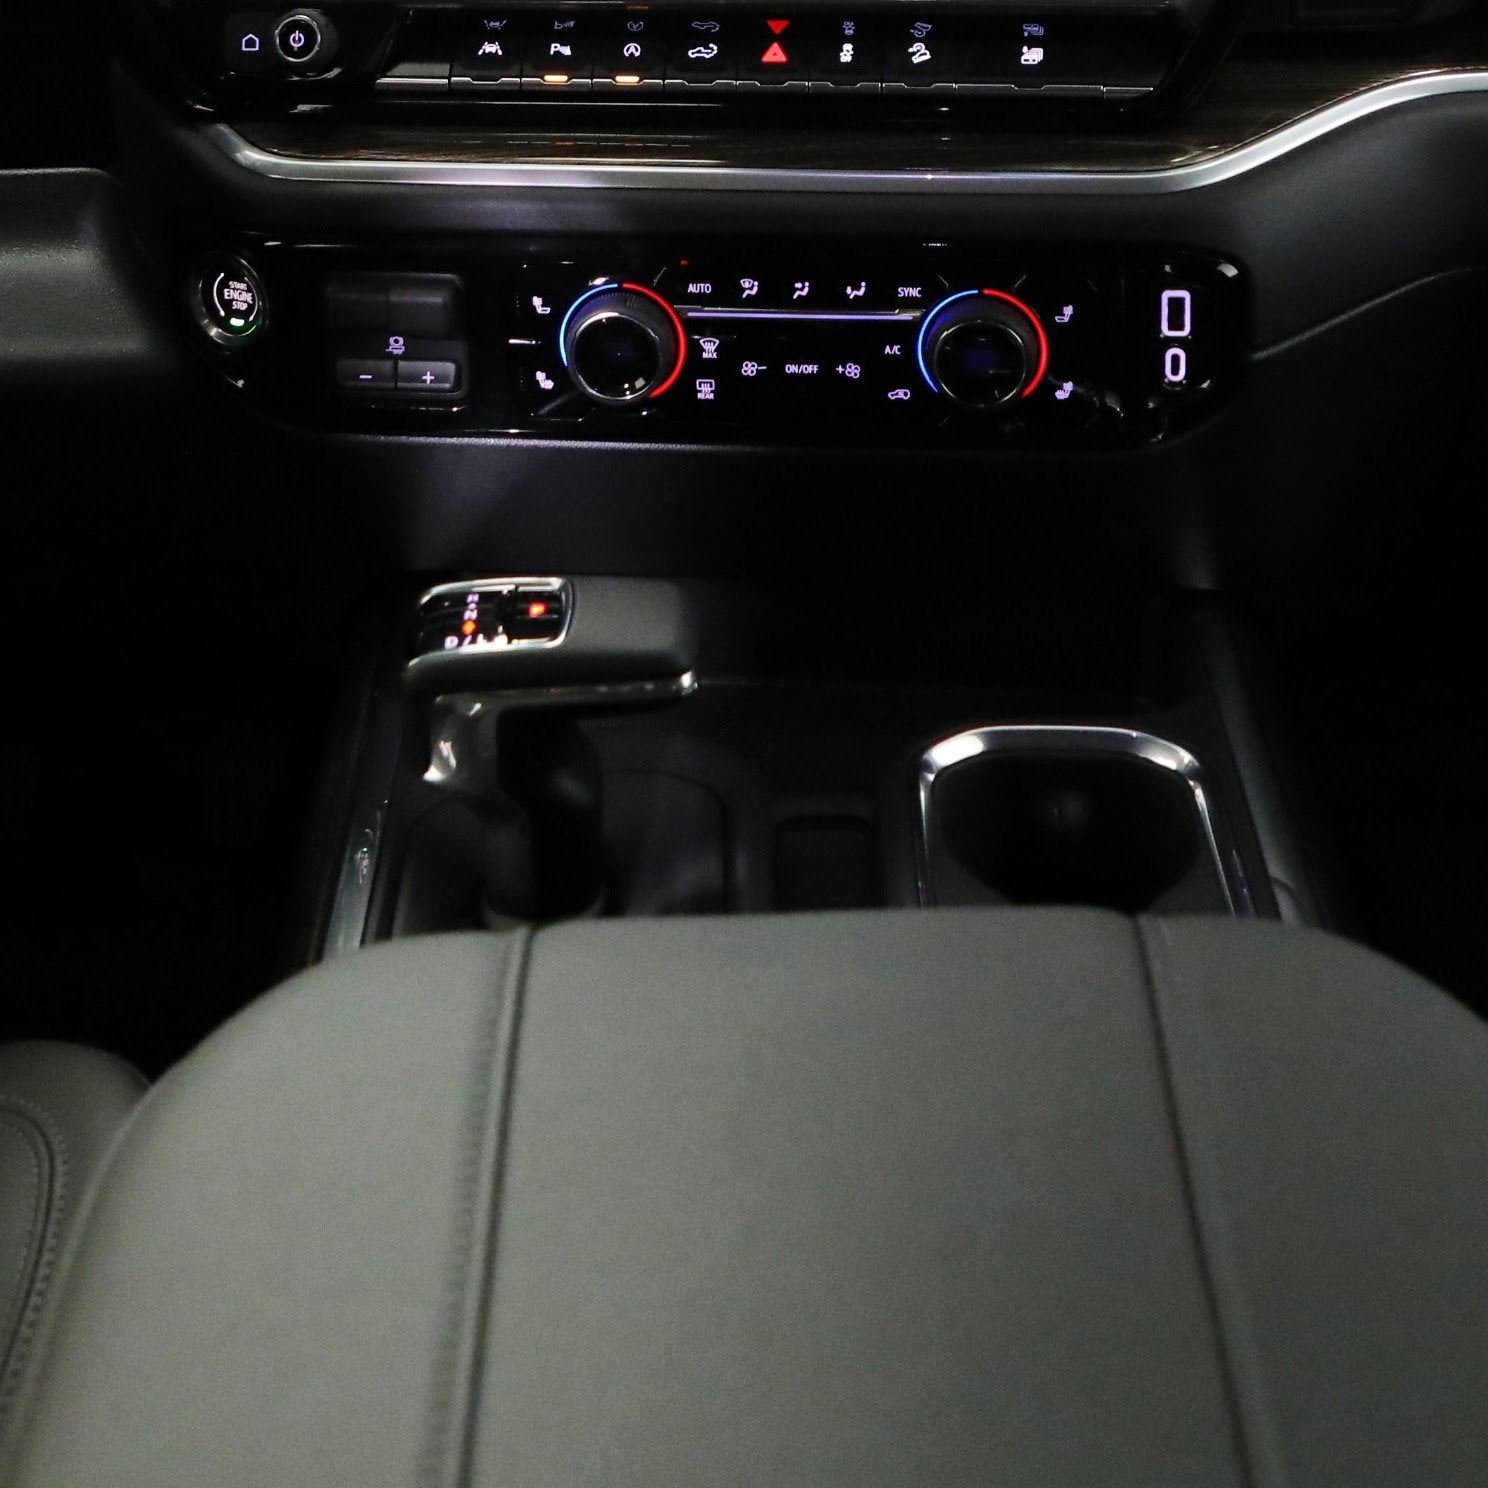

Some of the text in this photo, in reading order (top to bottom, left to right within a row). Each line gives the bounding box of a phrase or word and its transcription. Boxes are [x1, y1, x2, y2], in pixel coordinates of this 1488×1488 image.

[687, 283, 712, 294] AUTO
[897, 287, 922, 298] SYNC
[223, 288, 254, 304] ENGINE
[232, 300, 249, 311] STOP
[702, 351, 718, 359] MAX
[884, 345, 902, 355] A/C
[785, 364, 819, 374] ON/OFF
[697, 392, 715, 400] REAR
